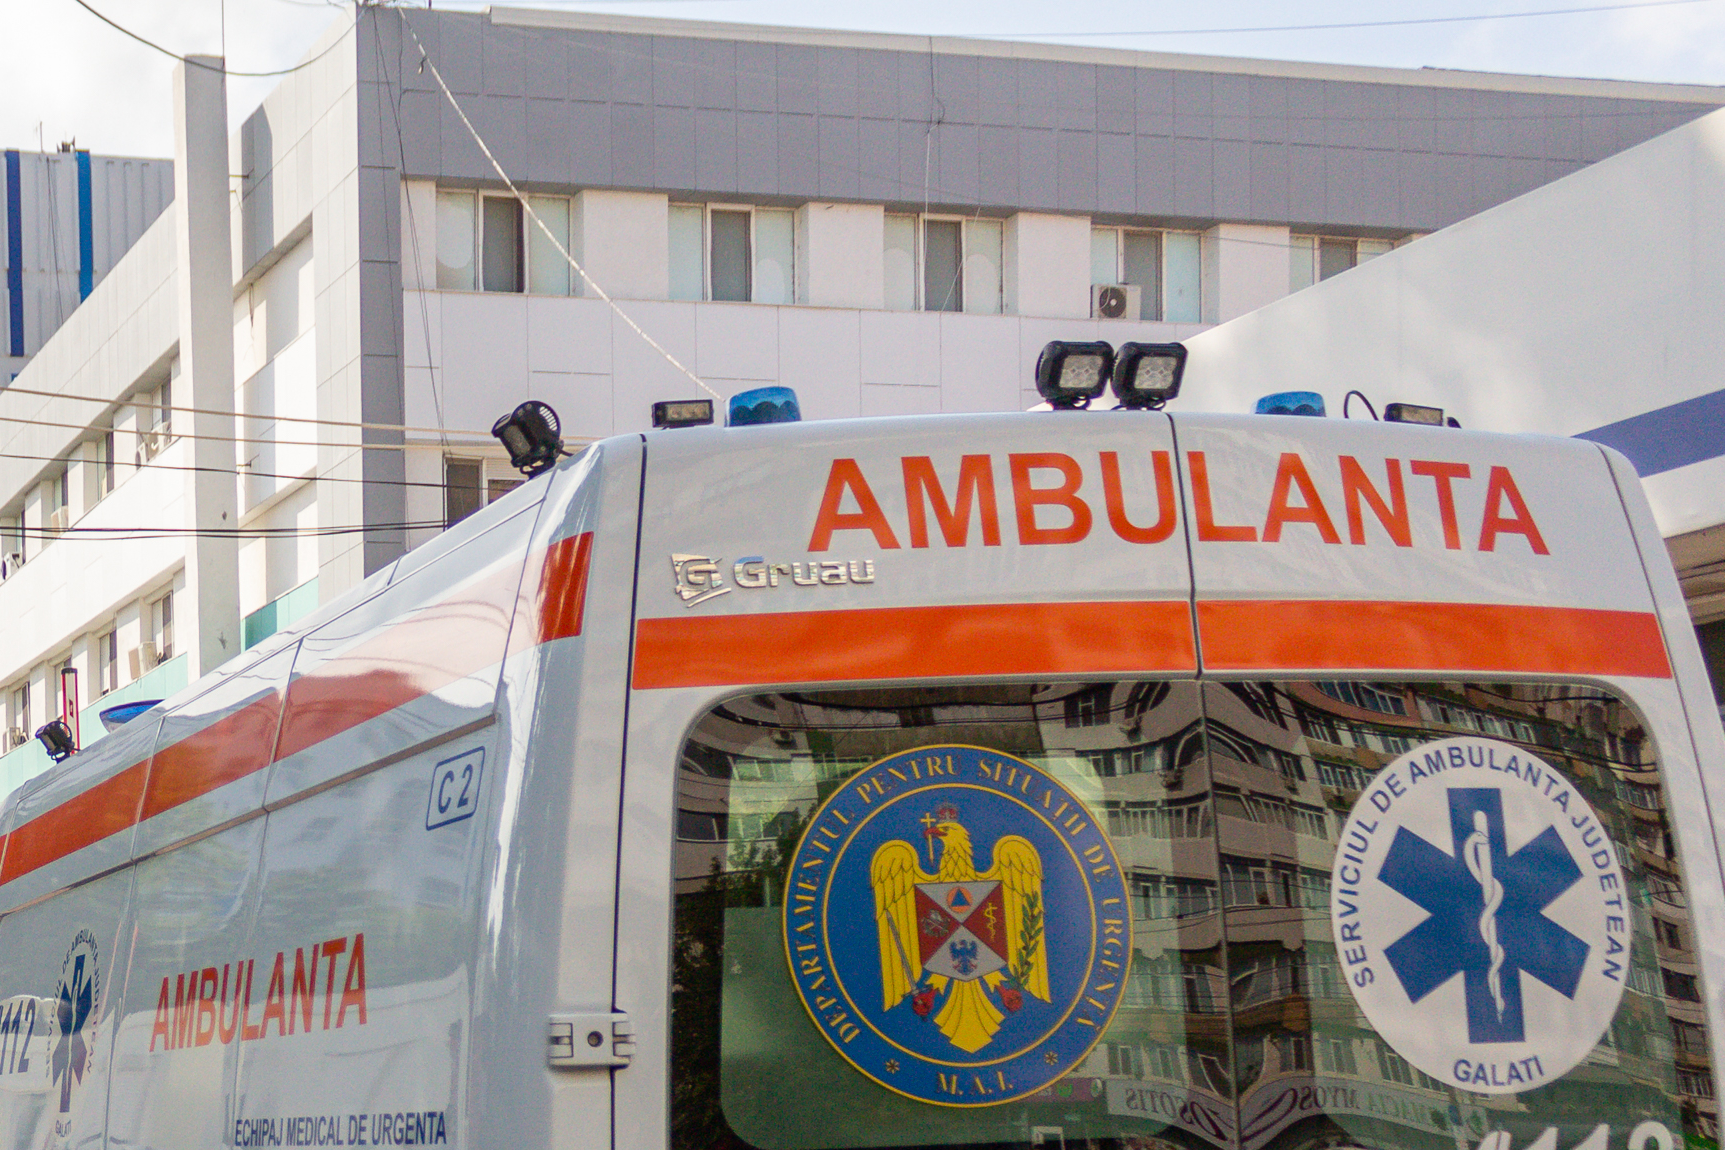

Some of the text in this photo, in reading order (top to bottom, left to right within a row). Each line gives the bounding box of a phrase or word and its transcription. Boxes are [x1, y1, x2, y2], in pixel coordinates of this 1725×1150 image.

[807, 449, 1550, 555] AMBULANTA
[733, 556, 875, 588] Gruau
[794, 808, 862, 1044] DEPARTAMENTUL
[856, 755, 964, 805] PENTRU
[1084, 844, 1114, 883] DE
[1338, 745, 1626, 989] SERVICIUL DE AMBULANTA JUDETEAN
[0, 998, 36, 1076] 112
[149, 932, 368, 1053] AMBULANTA
[1453, 1055, 1544, 1086] GALATI
[235, 1111, 447, 1147] ECHIPAJ MEDICAL DE URGENTA
